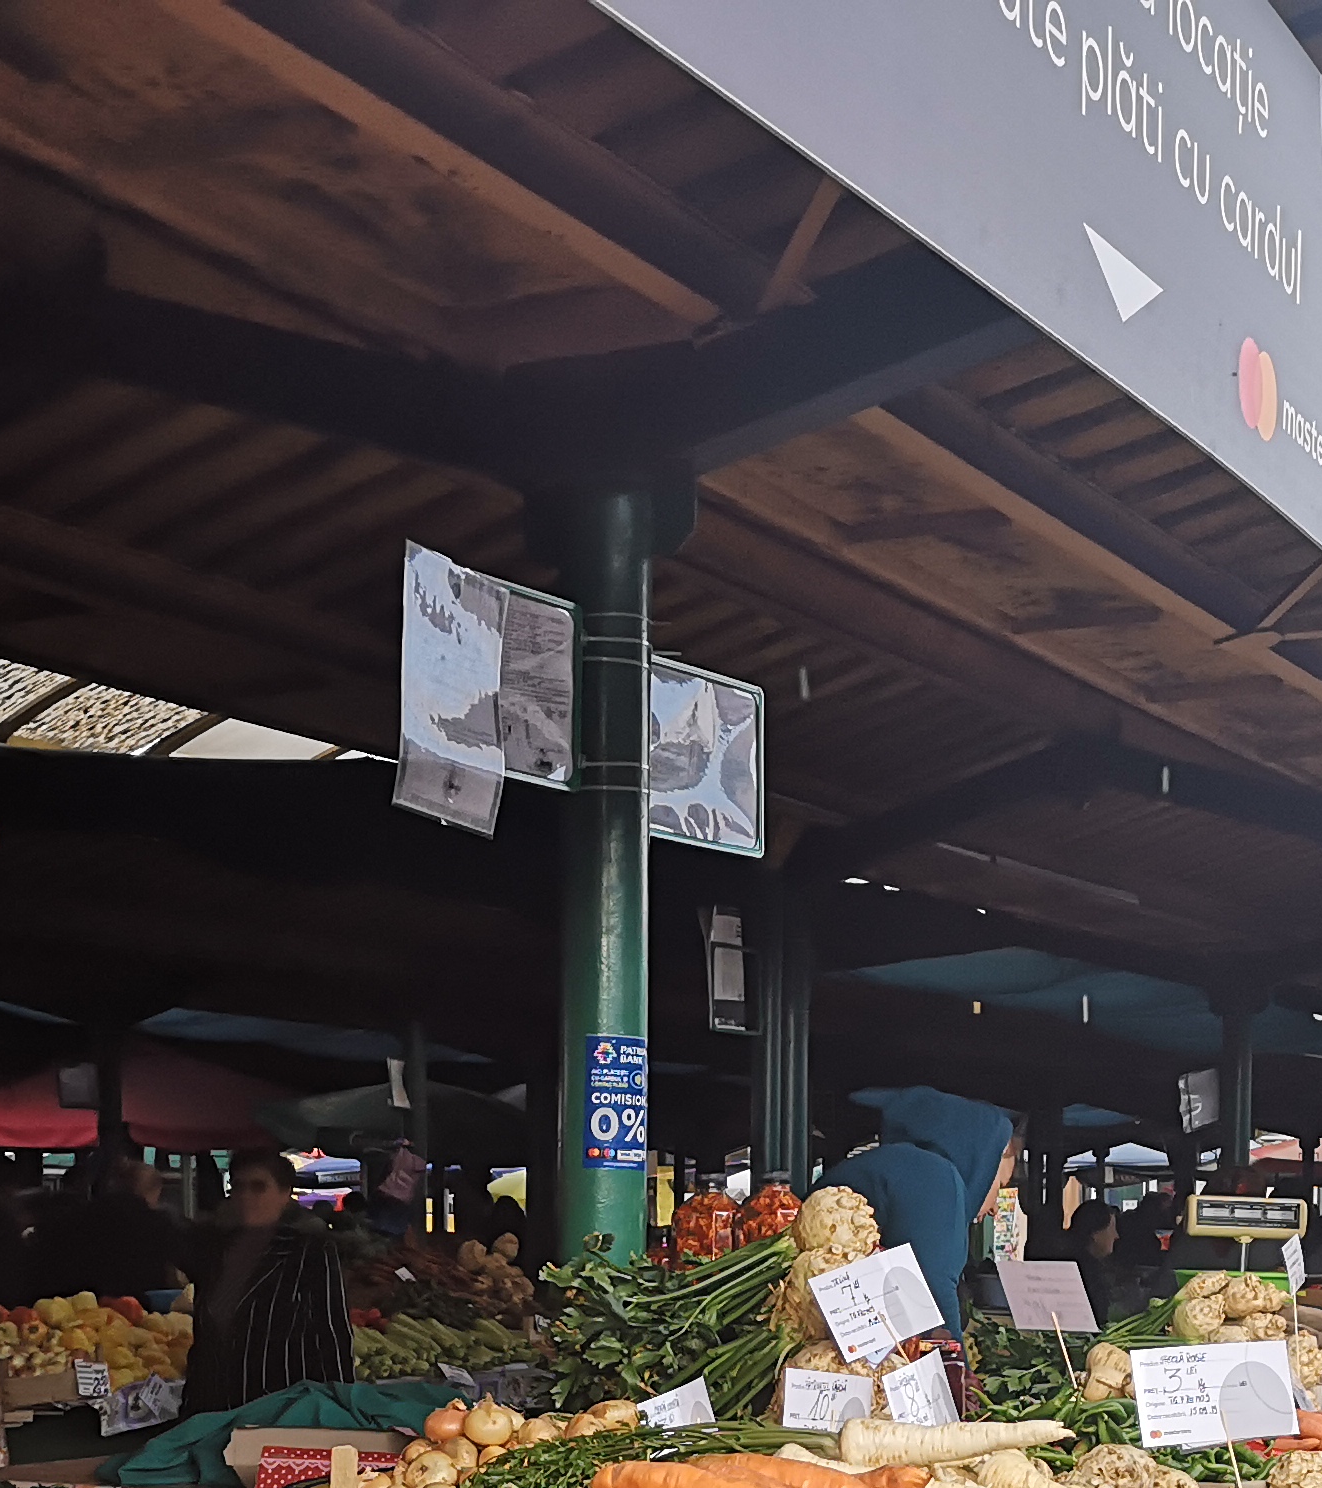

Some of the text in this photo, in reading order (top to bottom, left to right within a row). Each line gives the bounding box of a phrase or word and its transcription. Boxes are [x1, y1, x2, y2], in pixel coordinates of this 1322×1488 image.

[1081, 26, 1164, 163] plăti
[1175, 129, 1210, 204] cu
[1220, 174, 1302, 305] cardul
[590, 1107, 646, 1143] 0%
